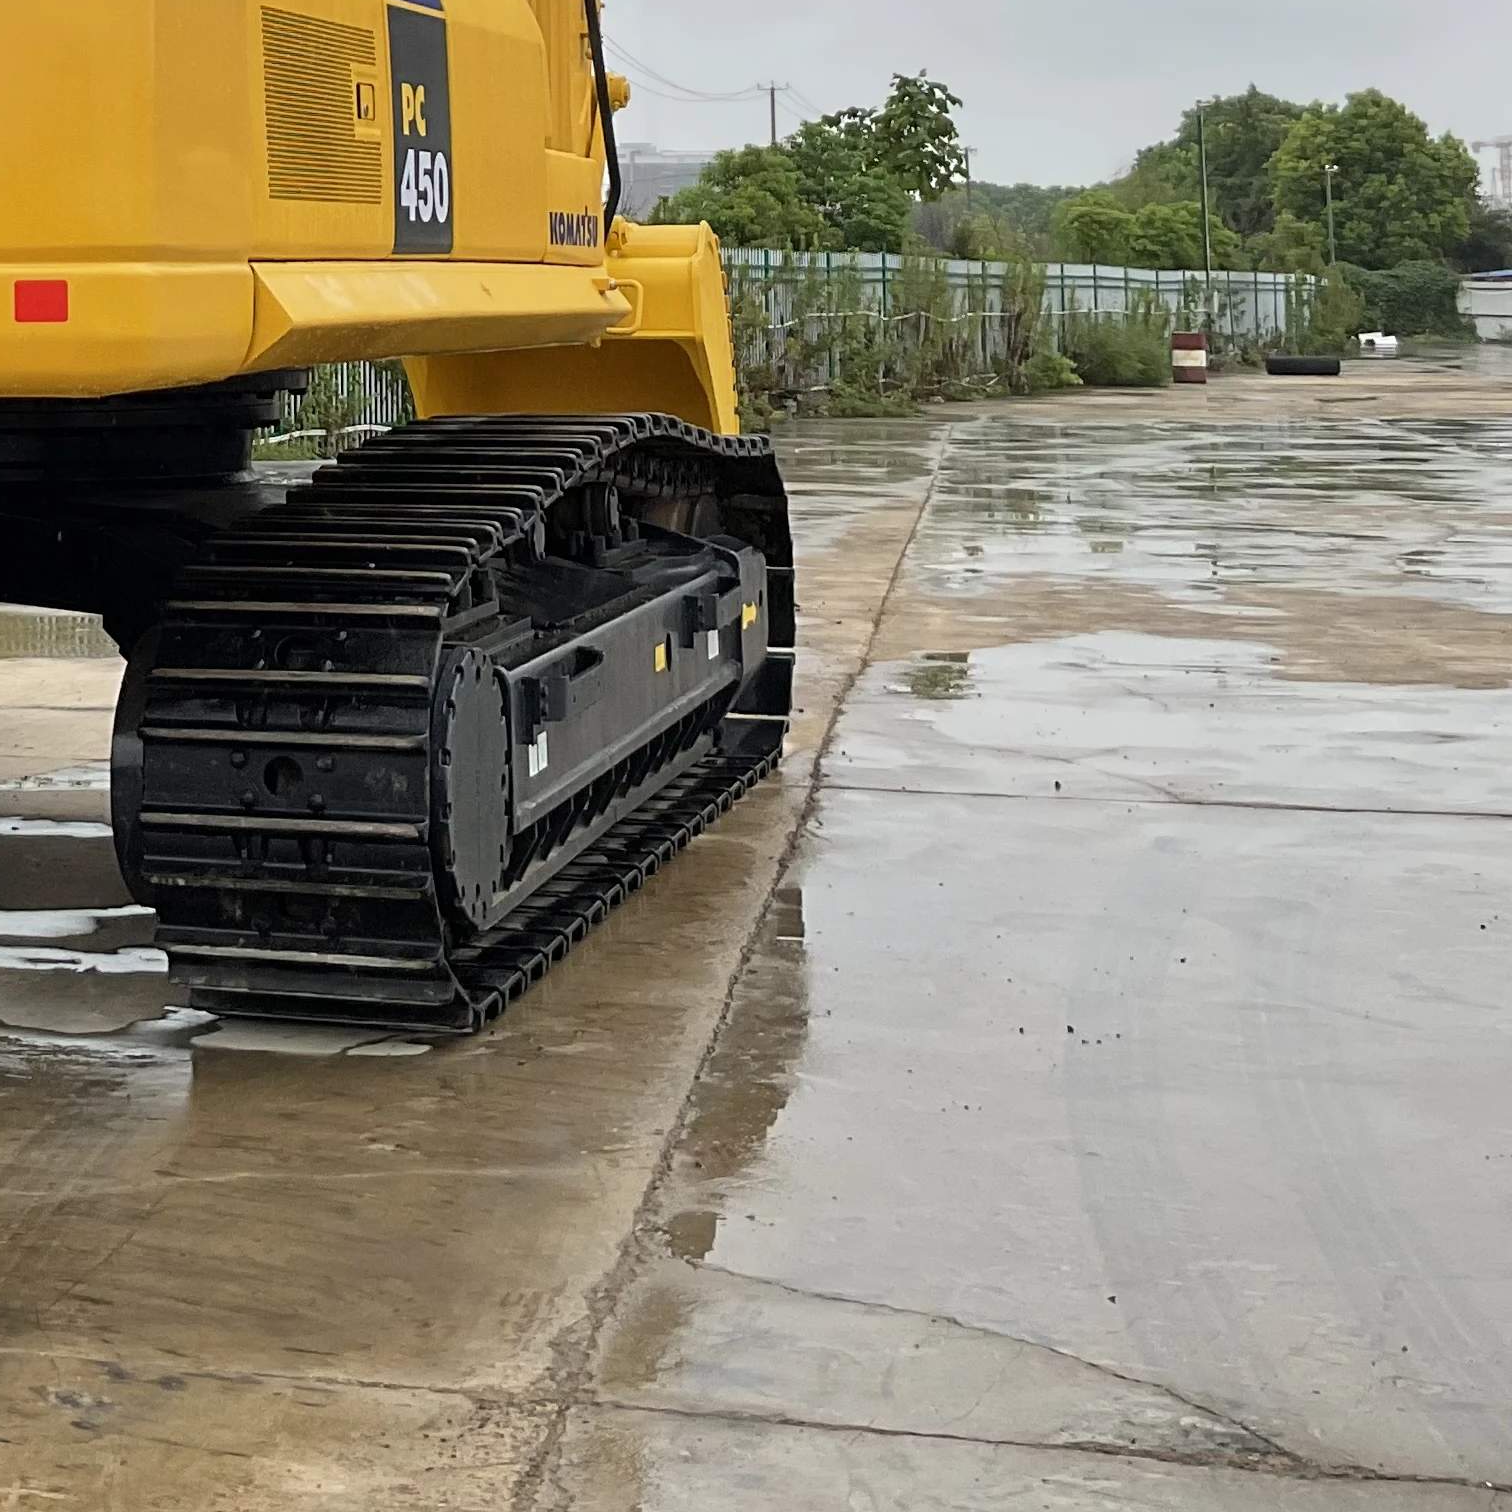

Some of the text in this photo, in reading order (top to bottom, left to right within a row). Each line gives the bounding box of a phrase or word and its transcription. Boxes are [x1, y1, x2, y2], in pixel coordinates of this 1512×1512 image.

[401, 83, 426, 137] PC
[400, 149, 449, 223] 450
[549, 205, 598, 248] KOMATSU
